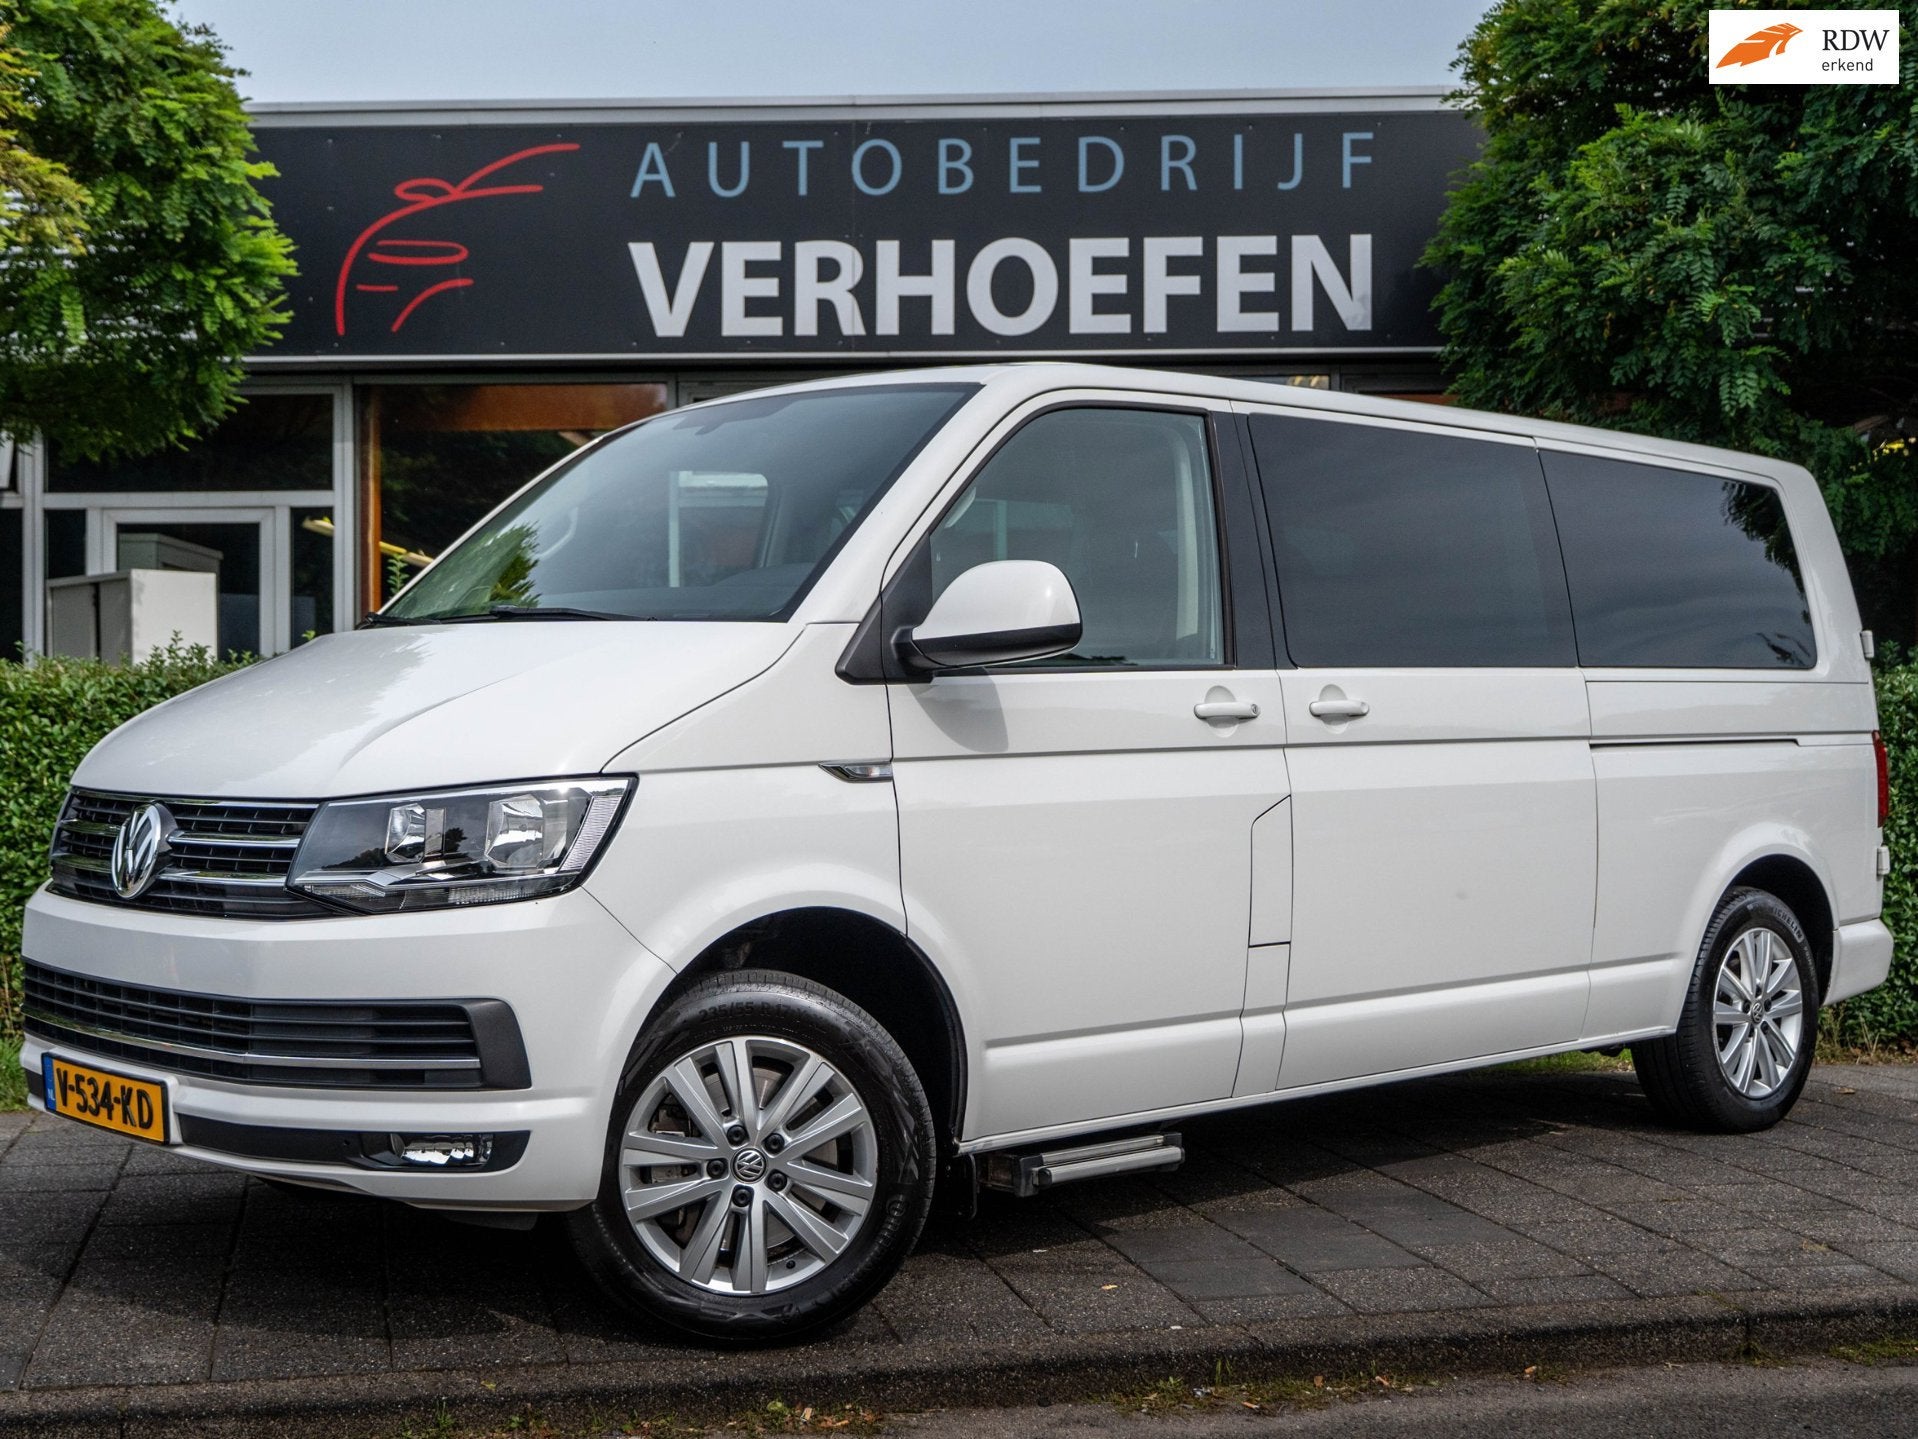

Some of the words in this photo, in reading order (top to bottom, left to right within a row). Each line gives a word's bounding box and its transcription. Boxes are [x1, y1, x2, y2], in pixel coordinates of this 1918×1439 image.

[630, 131, 1375, 198] AUTOBEDRIJF
[627, 233, 1373, 338] VERHOEFEN
[56, 1067, 154, 1130] V-534-KD
